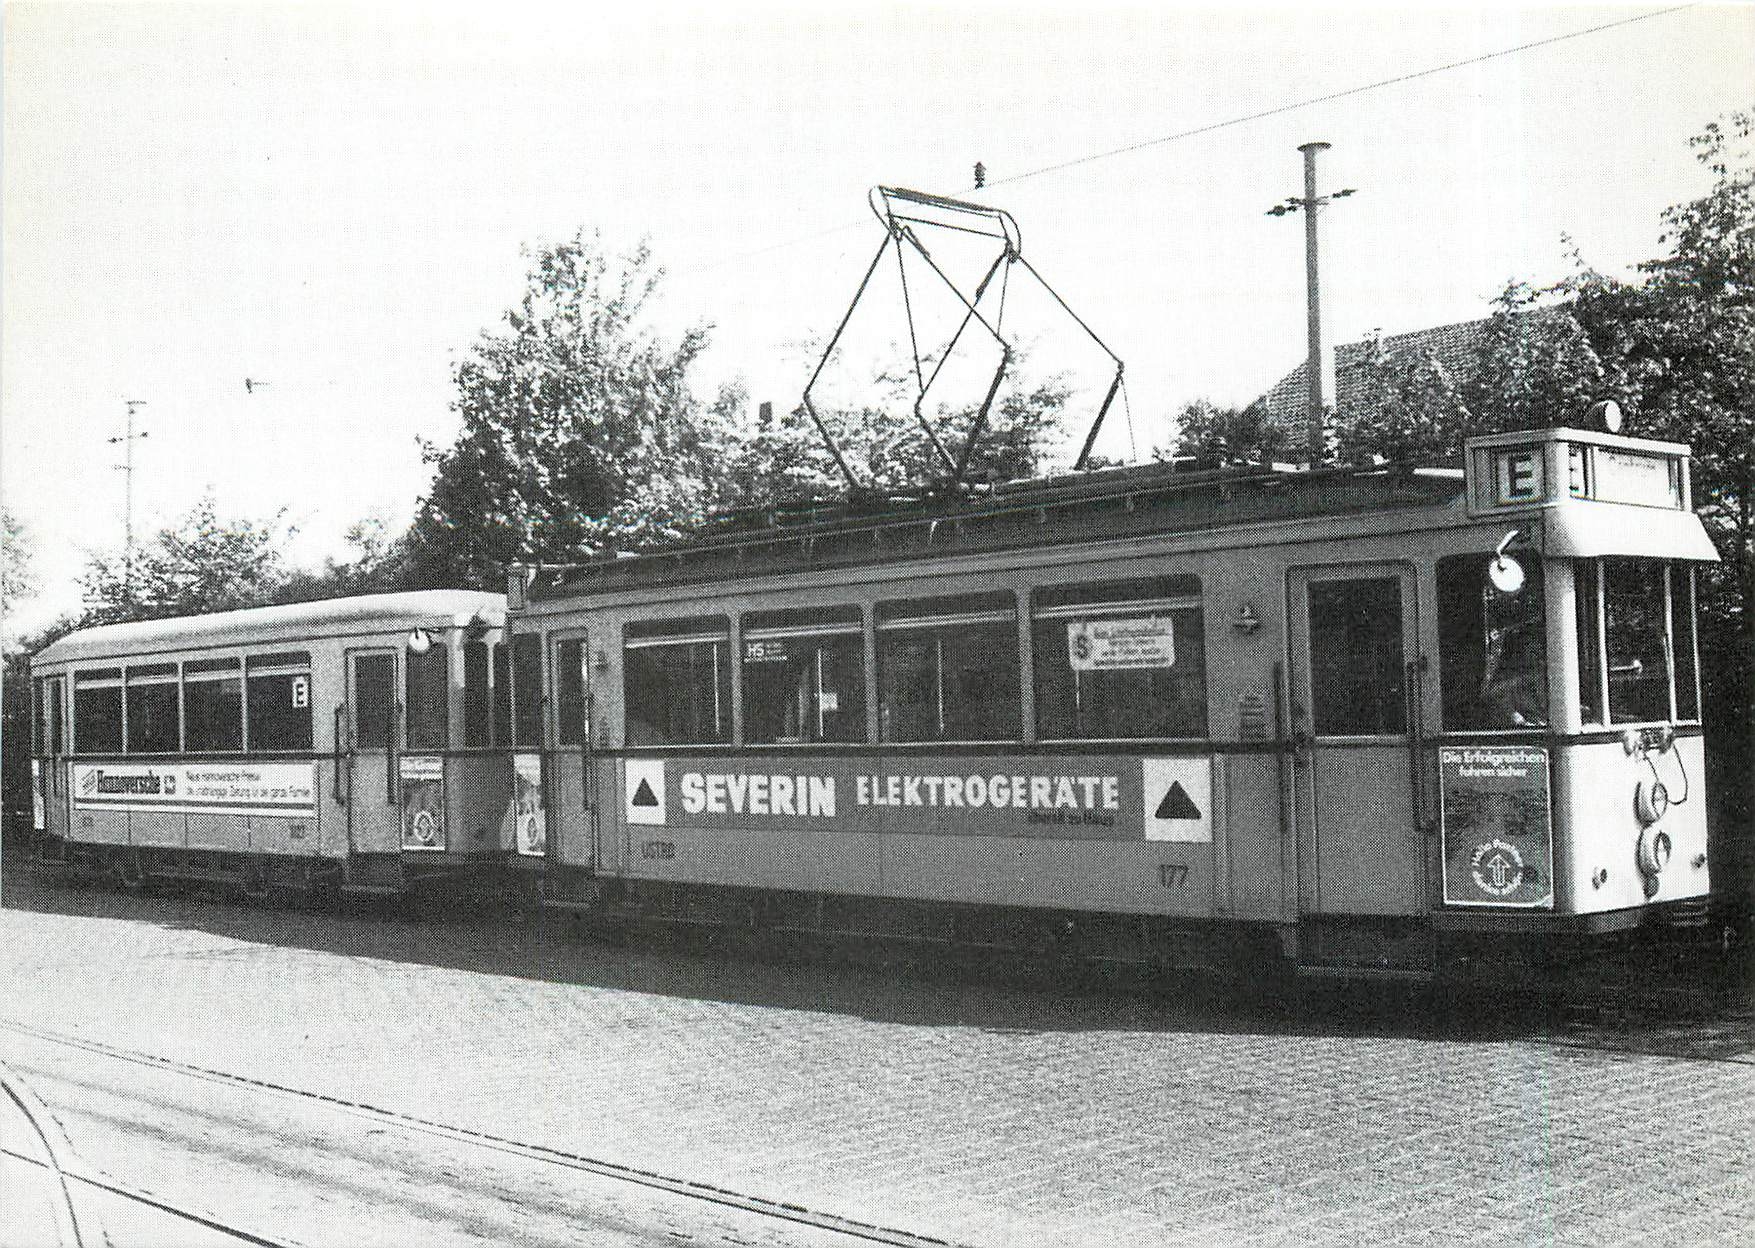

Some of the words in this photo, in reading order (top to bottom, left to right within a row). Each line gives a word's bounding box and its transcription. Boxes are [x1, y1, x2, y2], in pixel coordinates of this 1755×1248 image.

[1508, 454, 1533, 497] E
[296, 684, 304, 705] E
[1442, 751, 1462, 763] Die
[1464, 751, 1546, 767] Erfolgreichen
[1458, 766, 1495, 777] fahren
[1497, 765, 1528, 777] sicher
[681, 773, 836, 817] SEVERIN
[857, 775, 1119, 809] ELEKTROGERÄTE
[1160, 864, 1189, 889] 177
